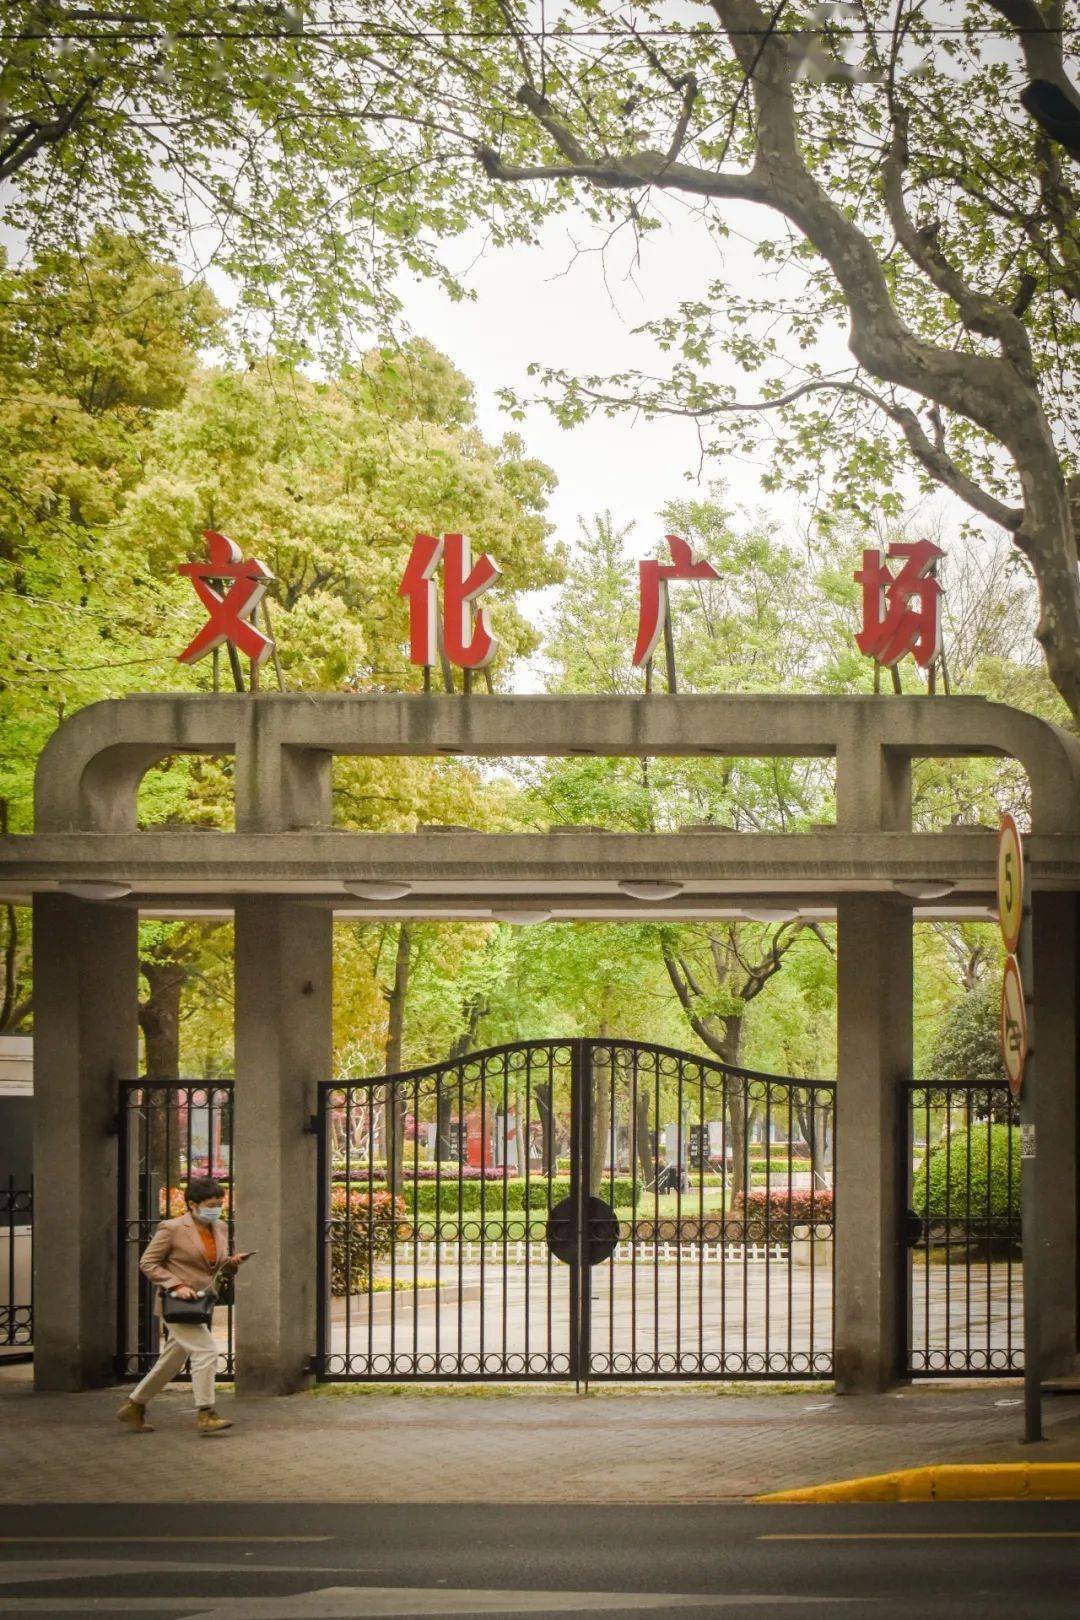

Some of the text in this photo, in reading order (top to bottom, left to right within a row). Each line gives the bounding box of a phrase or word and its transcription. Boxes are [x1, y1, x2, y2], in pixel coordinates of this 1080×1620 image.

[177, 529, 947, 669] 文化广场
[1005, 853, 1013, 913] 5
